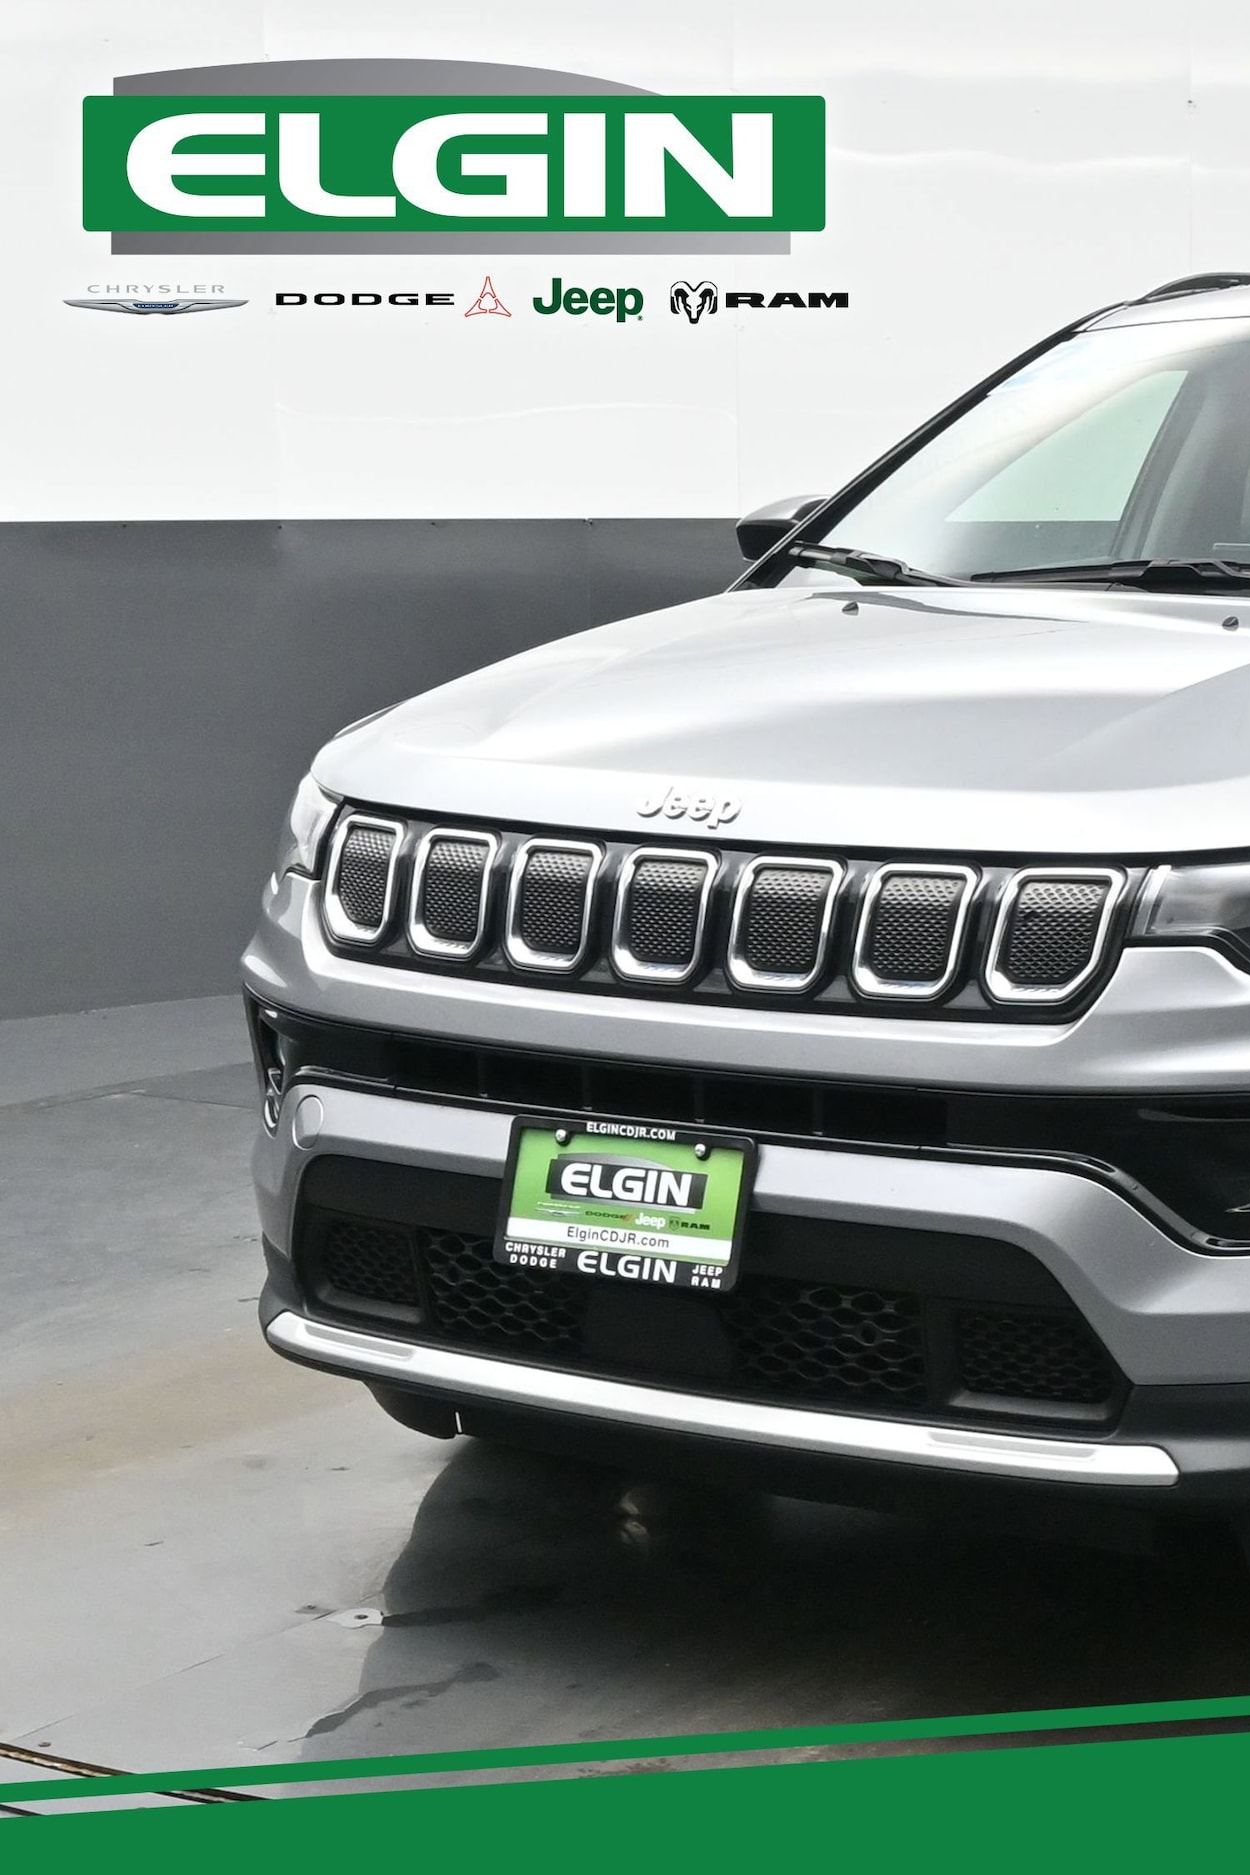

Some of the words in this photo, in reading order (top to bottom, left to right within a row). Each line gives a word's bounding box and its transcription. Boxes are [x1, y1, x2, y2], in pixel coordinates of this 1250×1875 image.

[636, 785, 742, 830] Jeep
[586, 1121, 676, 1141] ELGINCDJR.COM
[560, 1162, 693, 1207] ELGIN
[635, 1212, 666, 1230] Jeep
[680, 1222, 711, 1231] RAM
[566, 1226, 670, 1249] ElginCDJR.com
[505, 1241, 567, 1258] CHRYSLER
[509, 1254, 558, 1269] DODGE
[577, 1250, 677, 1284] ELGIN
[692, 1263, 723, 1278] JEEP
[691, 1275, 721, 1289] RAM
